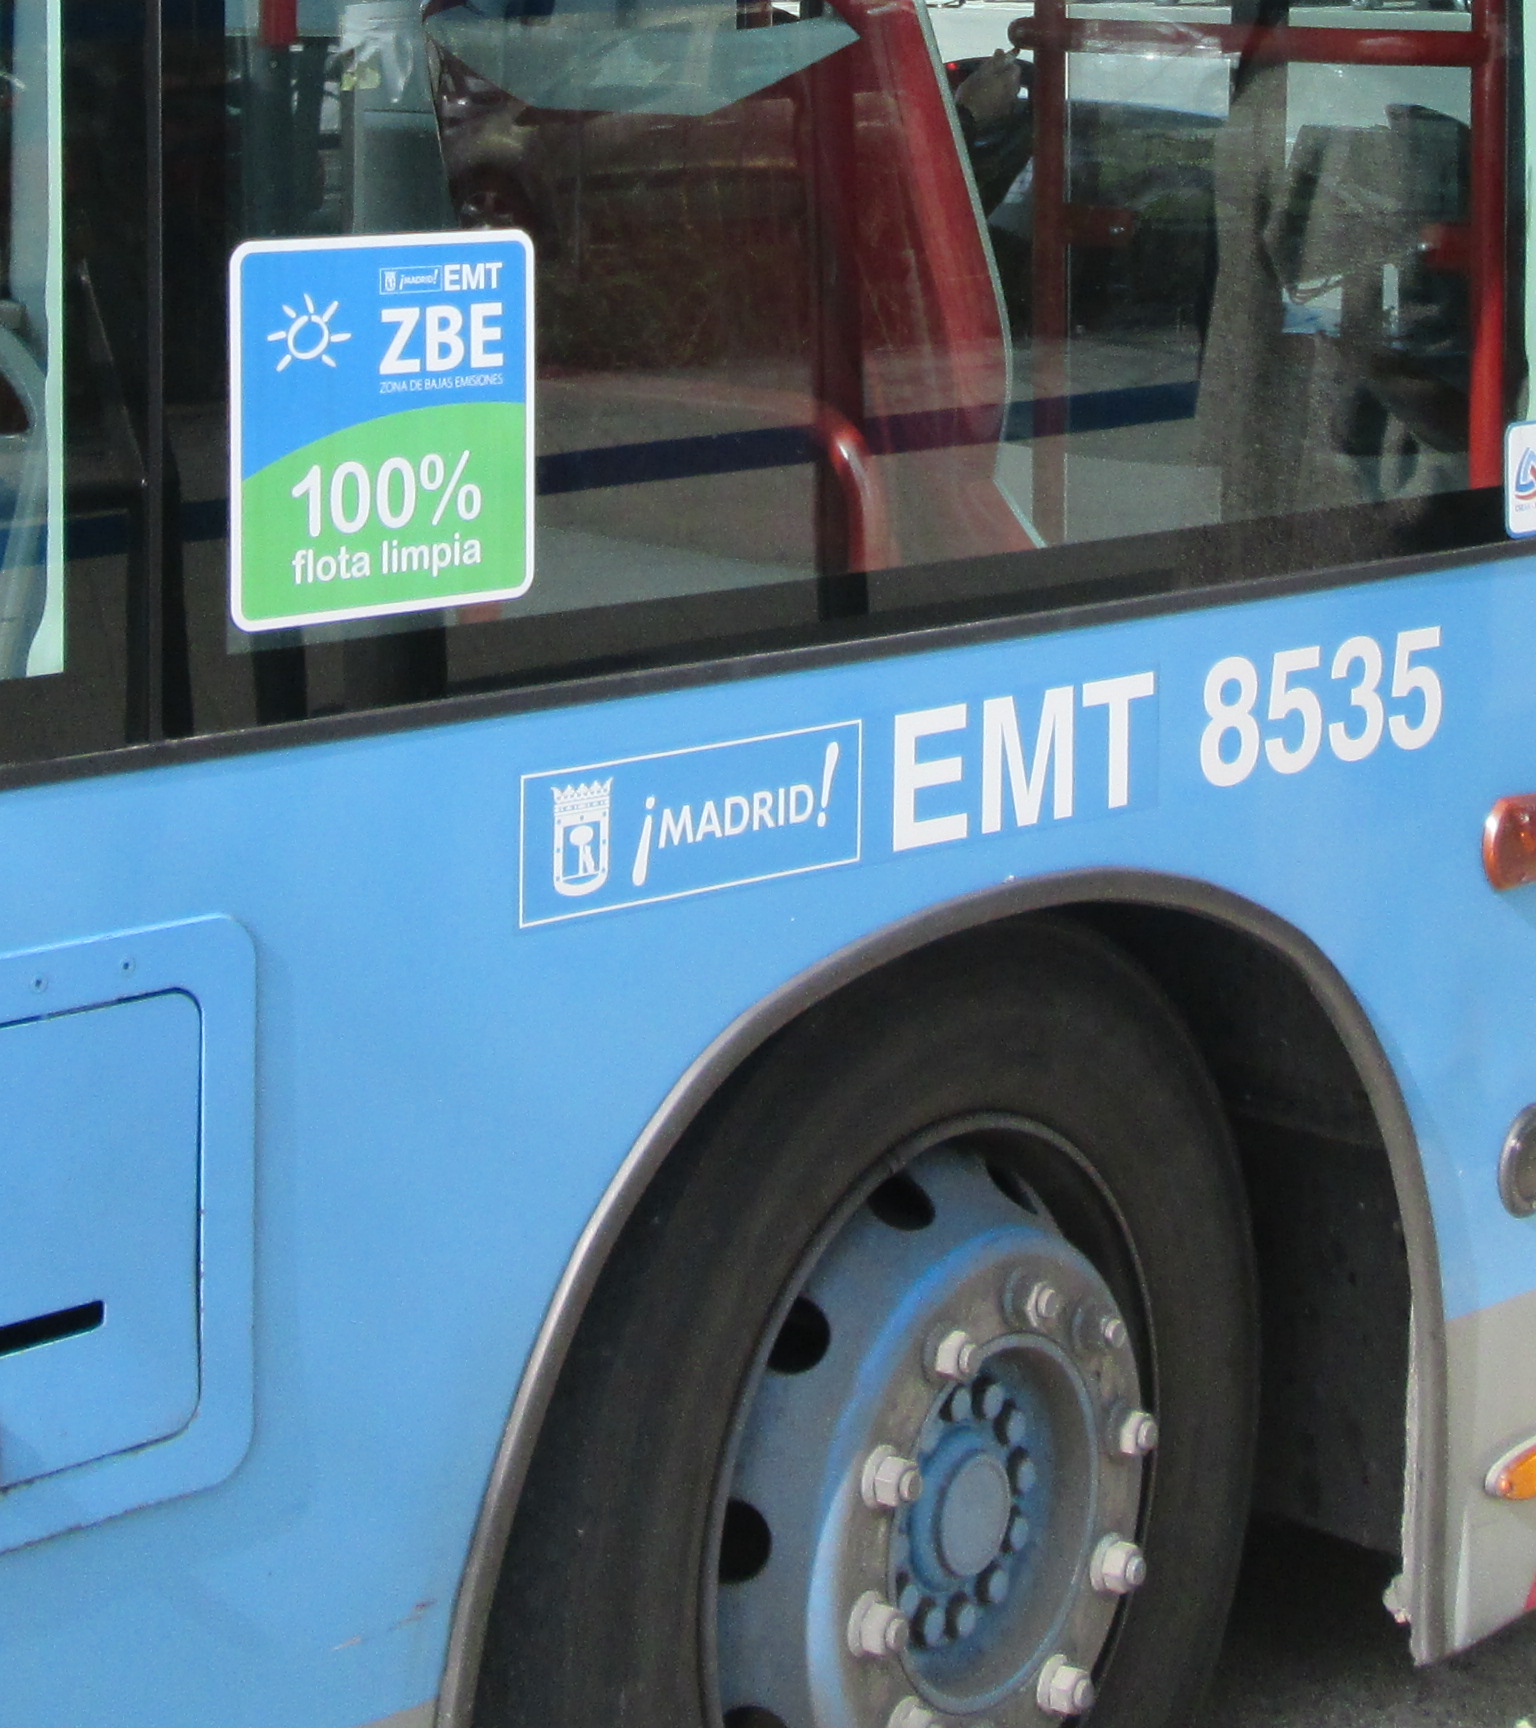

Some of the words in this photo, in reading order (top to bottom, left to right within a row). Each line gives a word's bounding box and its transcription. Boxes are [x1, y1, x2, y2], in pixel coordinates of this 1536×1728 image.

[443, 261, 503, 292] EMT
[379, 301, 504, 375] ZBE
[379, 380, 408, 394] ZONA
[409, 379, 423, 391] DE
[424, 376, 453, 390] BAJAS
[454, 373, 504, 389] EMISIONES
[291, 449, 482, 537] 100%
[291, 548, 371, 585] flota
[380, 532, 482, 577] limpia
[631, 741, 840, 886] ¡MADRID!
[892, 671, 1155, 853] EMT
[1199, 625, 1445, 788] 8535
